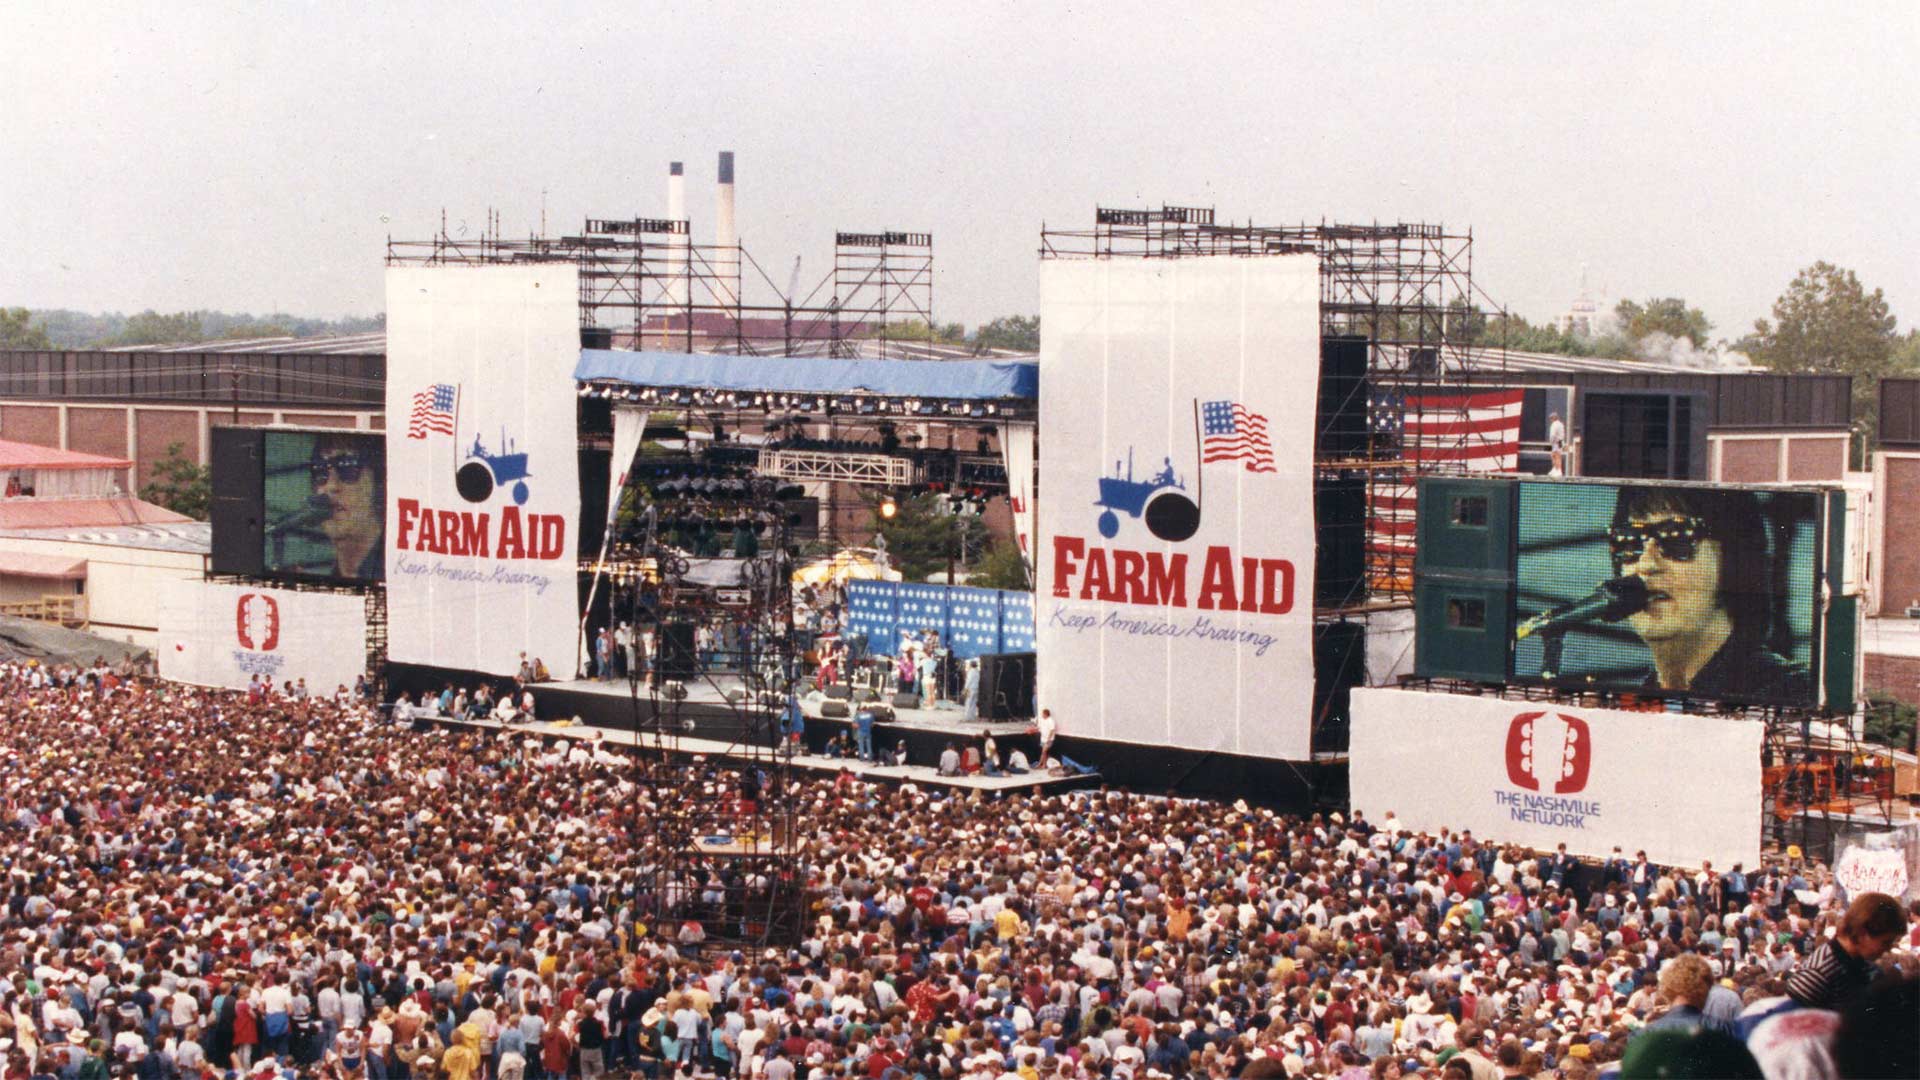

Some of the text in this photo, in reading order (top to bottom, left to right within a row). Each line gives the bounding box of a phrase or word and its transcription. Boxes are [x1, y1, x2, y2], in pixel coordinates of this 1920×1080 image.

[397, 498, 565, 560] FARM AID
[1053, 536, 1295, 615] FARM AID
[1049, 605, 1279, 657] Keep America Growing
[1494, 790, 1601, 817] THE NASHVILLE
[1511, 807, 1584, 829] NETWORK
